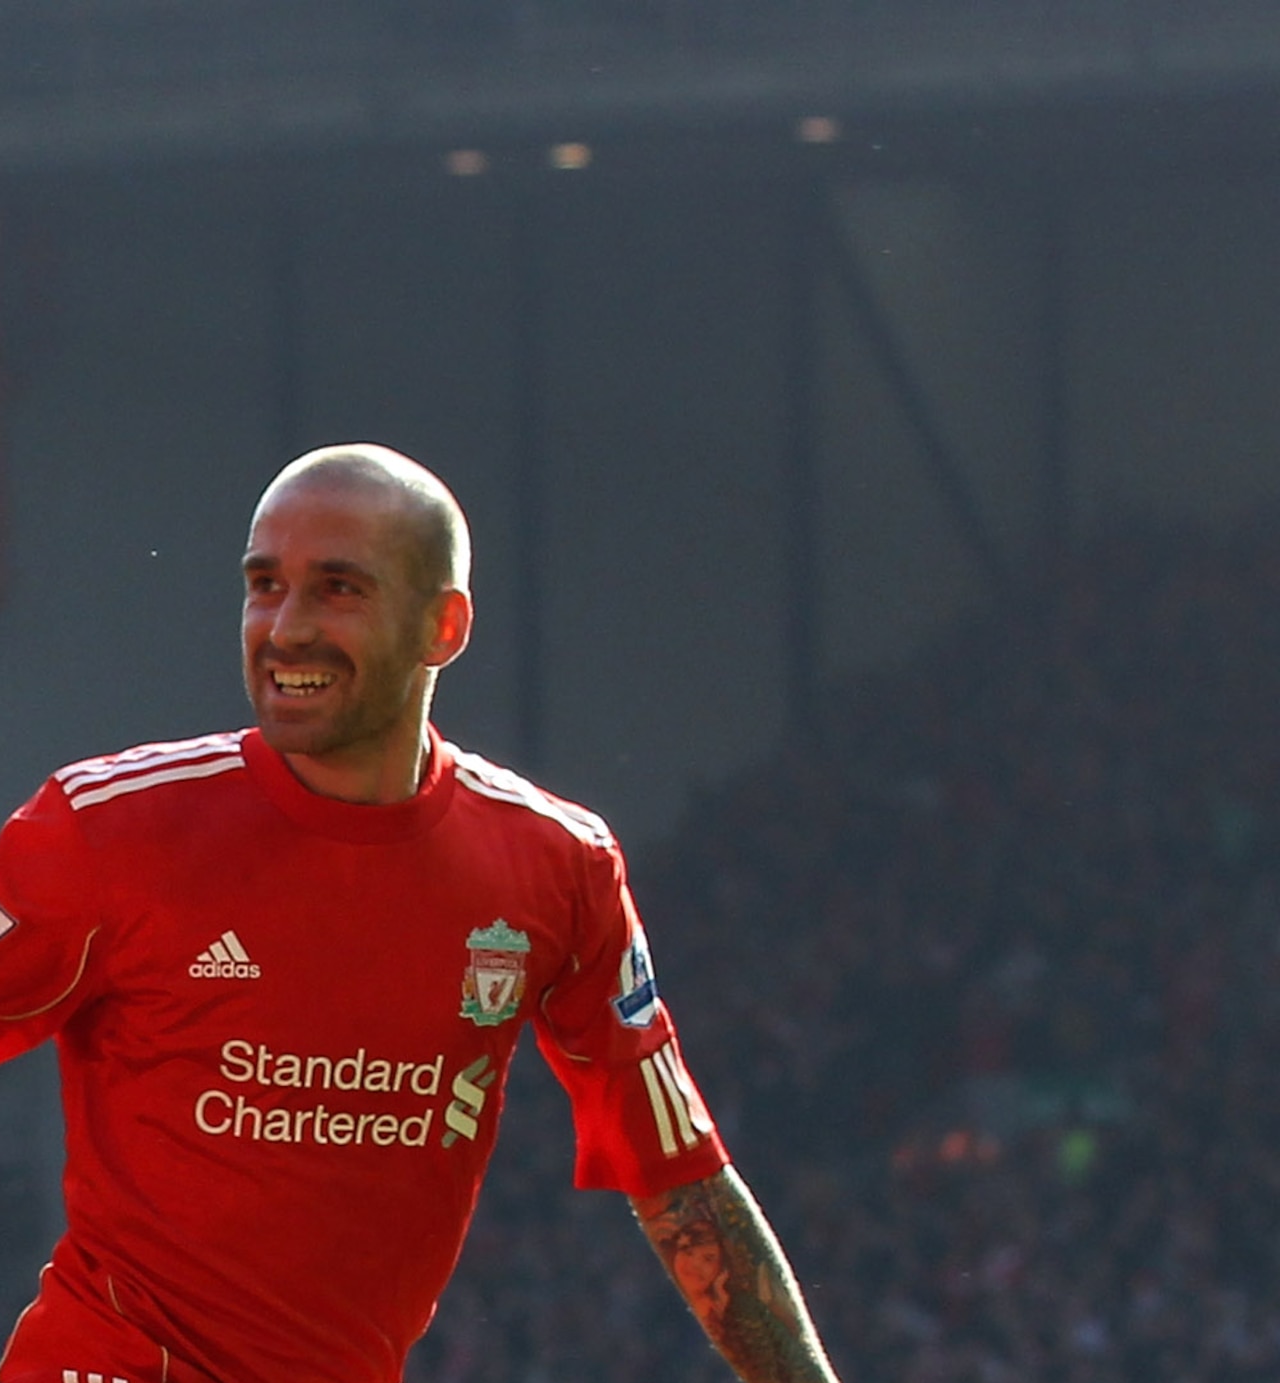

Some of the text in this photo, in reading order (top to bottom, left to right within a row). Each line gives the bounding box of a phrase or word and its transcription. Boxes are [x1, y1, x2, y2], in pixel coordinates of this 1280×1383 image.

[189, 960, 261, 979] adidas
[220, 1039, 443, 1096] Standard
[194, 1090, 433, 1147] Chartered
